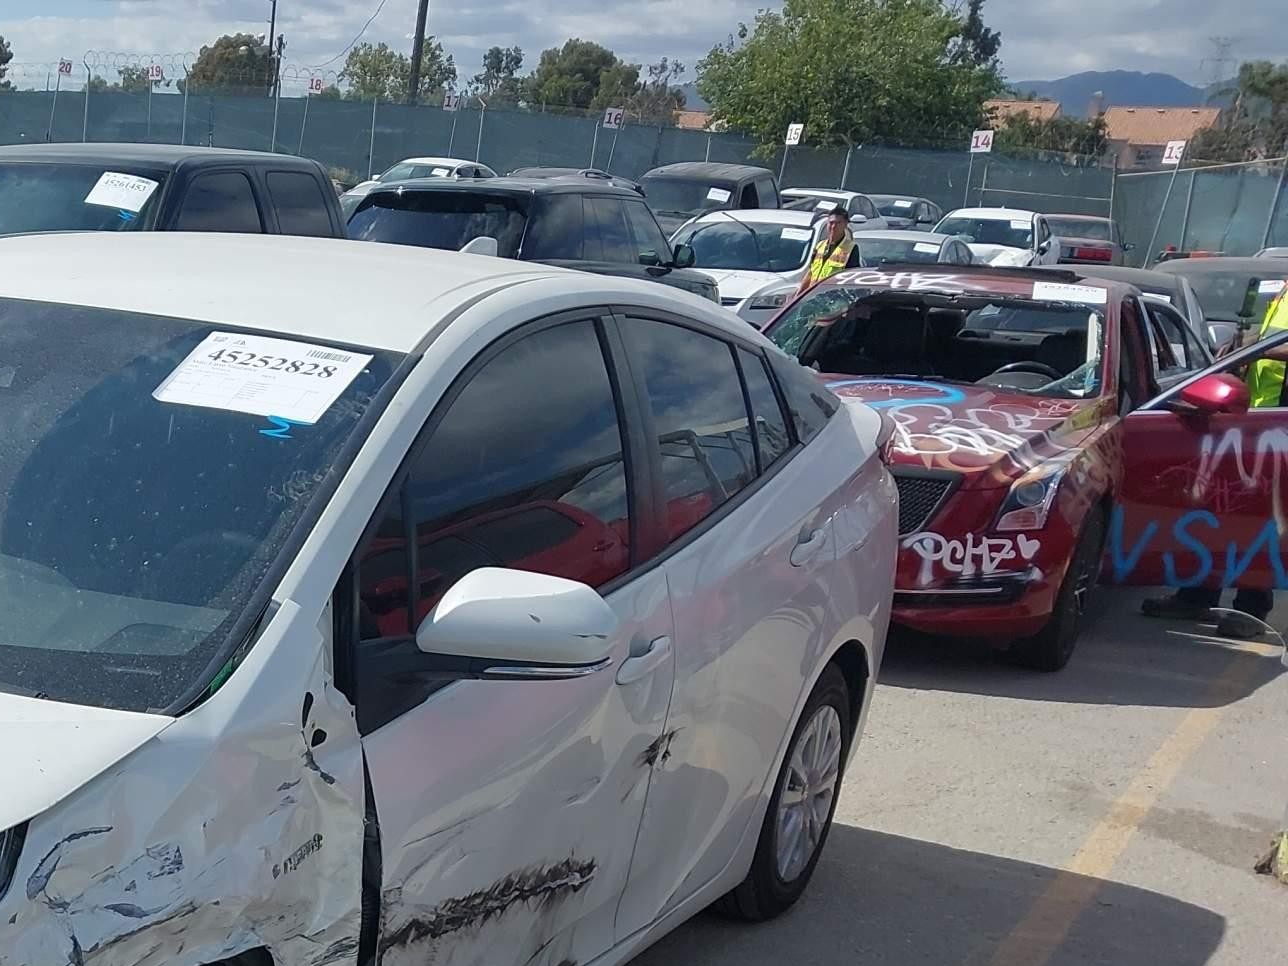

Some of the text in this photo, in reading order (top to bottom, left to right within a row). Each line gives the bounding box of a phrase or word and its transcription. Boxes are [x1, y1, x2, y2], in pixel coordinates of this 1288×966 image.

[59, 62, 72, 73] 20
[149, 65, 161, 77] 19
[309, 78, 322, 90] 18
[444, 95, 459, 108] 17
[605, 112, 622, 125] 16
[787, 128, 801, 141] 15
[972, 135, 991, 149] 14
[208, 348, 338, 379] 45252828
